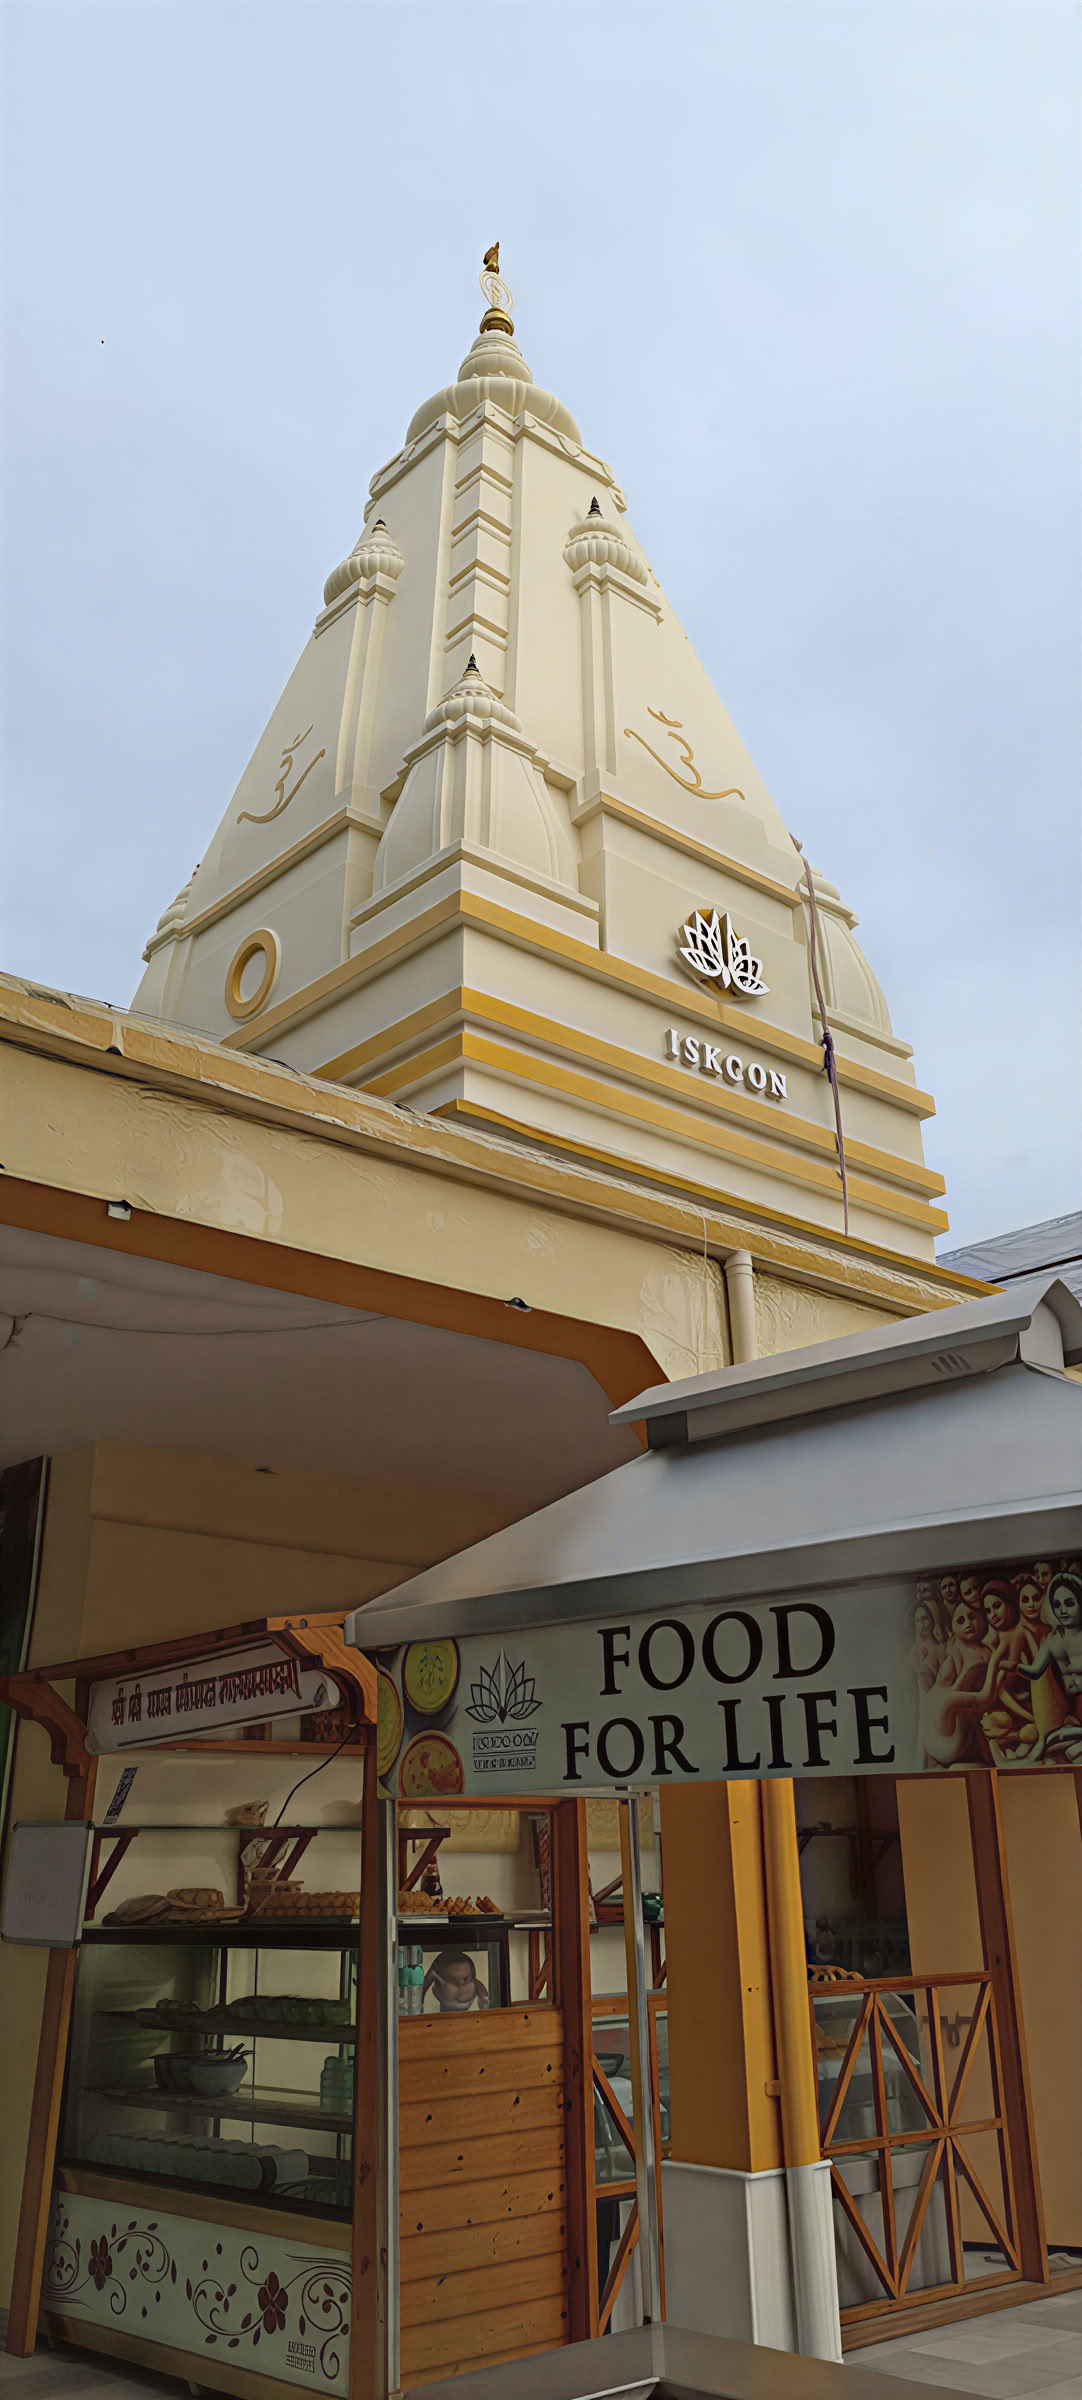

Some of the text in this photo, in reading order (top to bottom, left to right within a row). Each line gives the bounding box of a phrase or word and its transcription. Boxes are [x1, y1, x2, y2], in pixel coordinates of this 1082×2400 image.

[664, 1028, 789, 1101] ISKCON
[596, 1602, 836, 1697] FOOD
[560, 1685, 896, 1781] FOR LIFE
